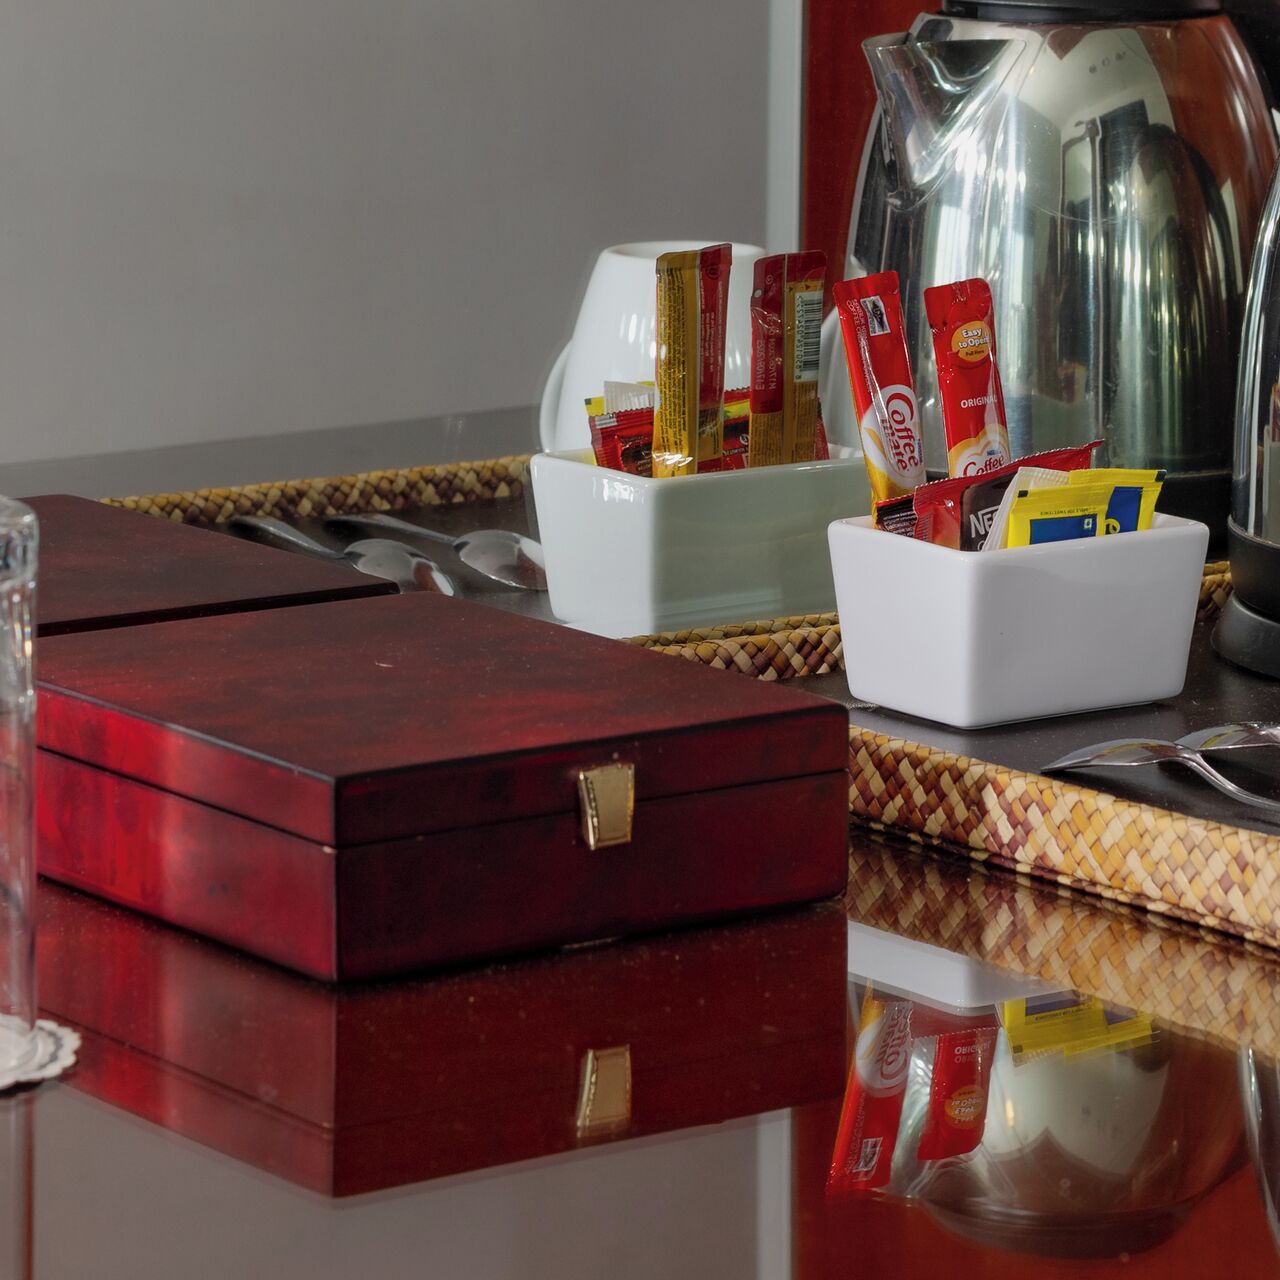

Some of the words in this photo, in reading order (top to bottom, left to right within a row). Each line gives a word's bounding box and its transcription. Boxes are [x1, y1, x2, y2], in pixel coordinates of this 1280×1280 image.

[961, 328, 982, 338] Easy
[958, 341, 968, 349] to
[960, 394, 997, 408] ORIGINAL
[886, 392, 919, 467] Coffee
[962, 454, 1005, 477] Coffee
